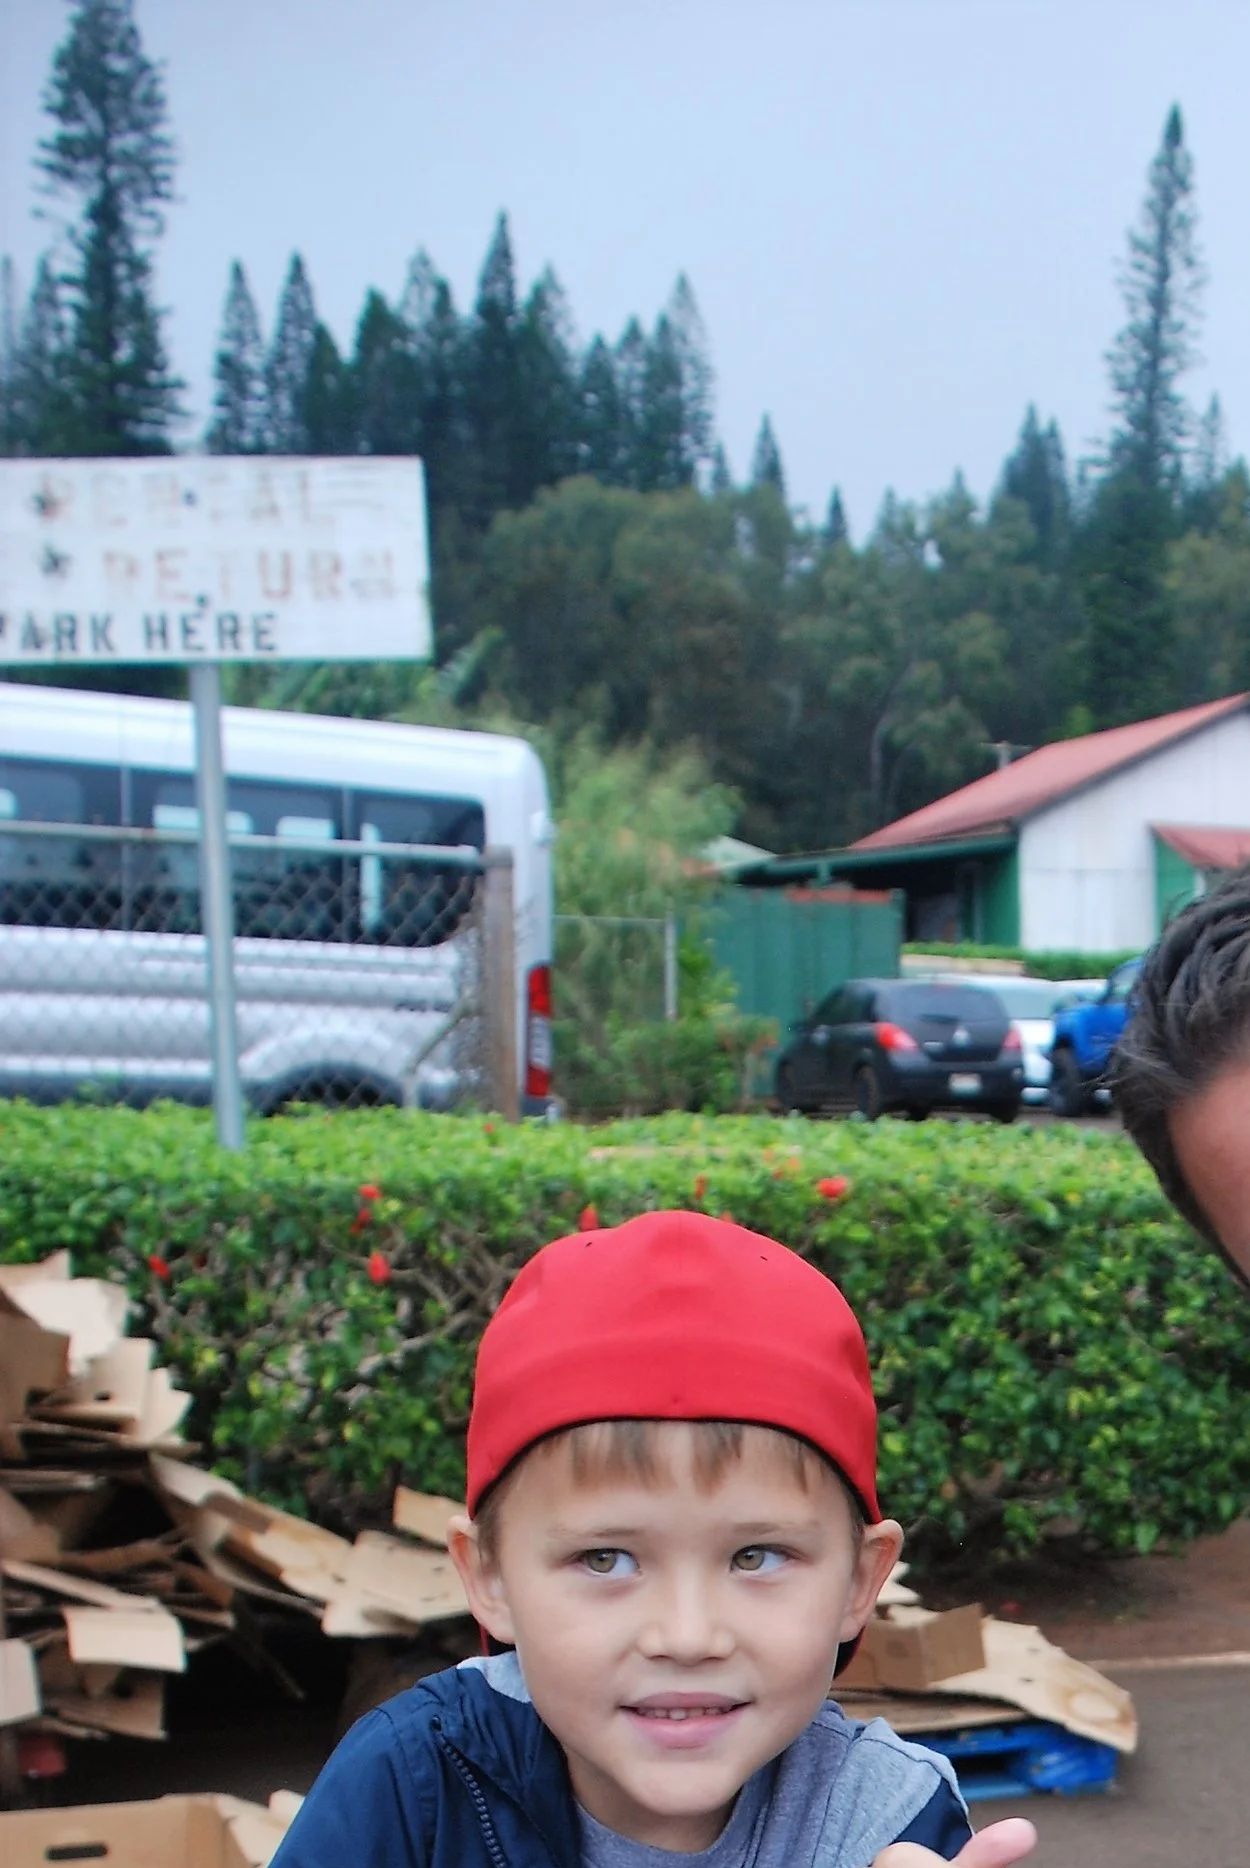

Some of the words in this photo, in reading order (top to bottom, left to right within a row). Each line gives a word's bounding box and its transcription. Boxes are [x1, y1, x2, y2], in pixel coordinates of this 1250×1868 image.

[101, 546, 397, 601] RETURN
[0, 612, 116, 652] ARK
[144, 611, 280, 652] HERE
